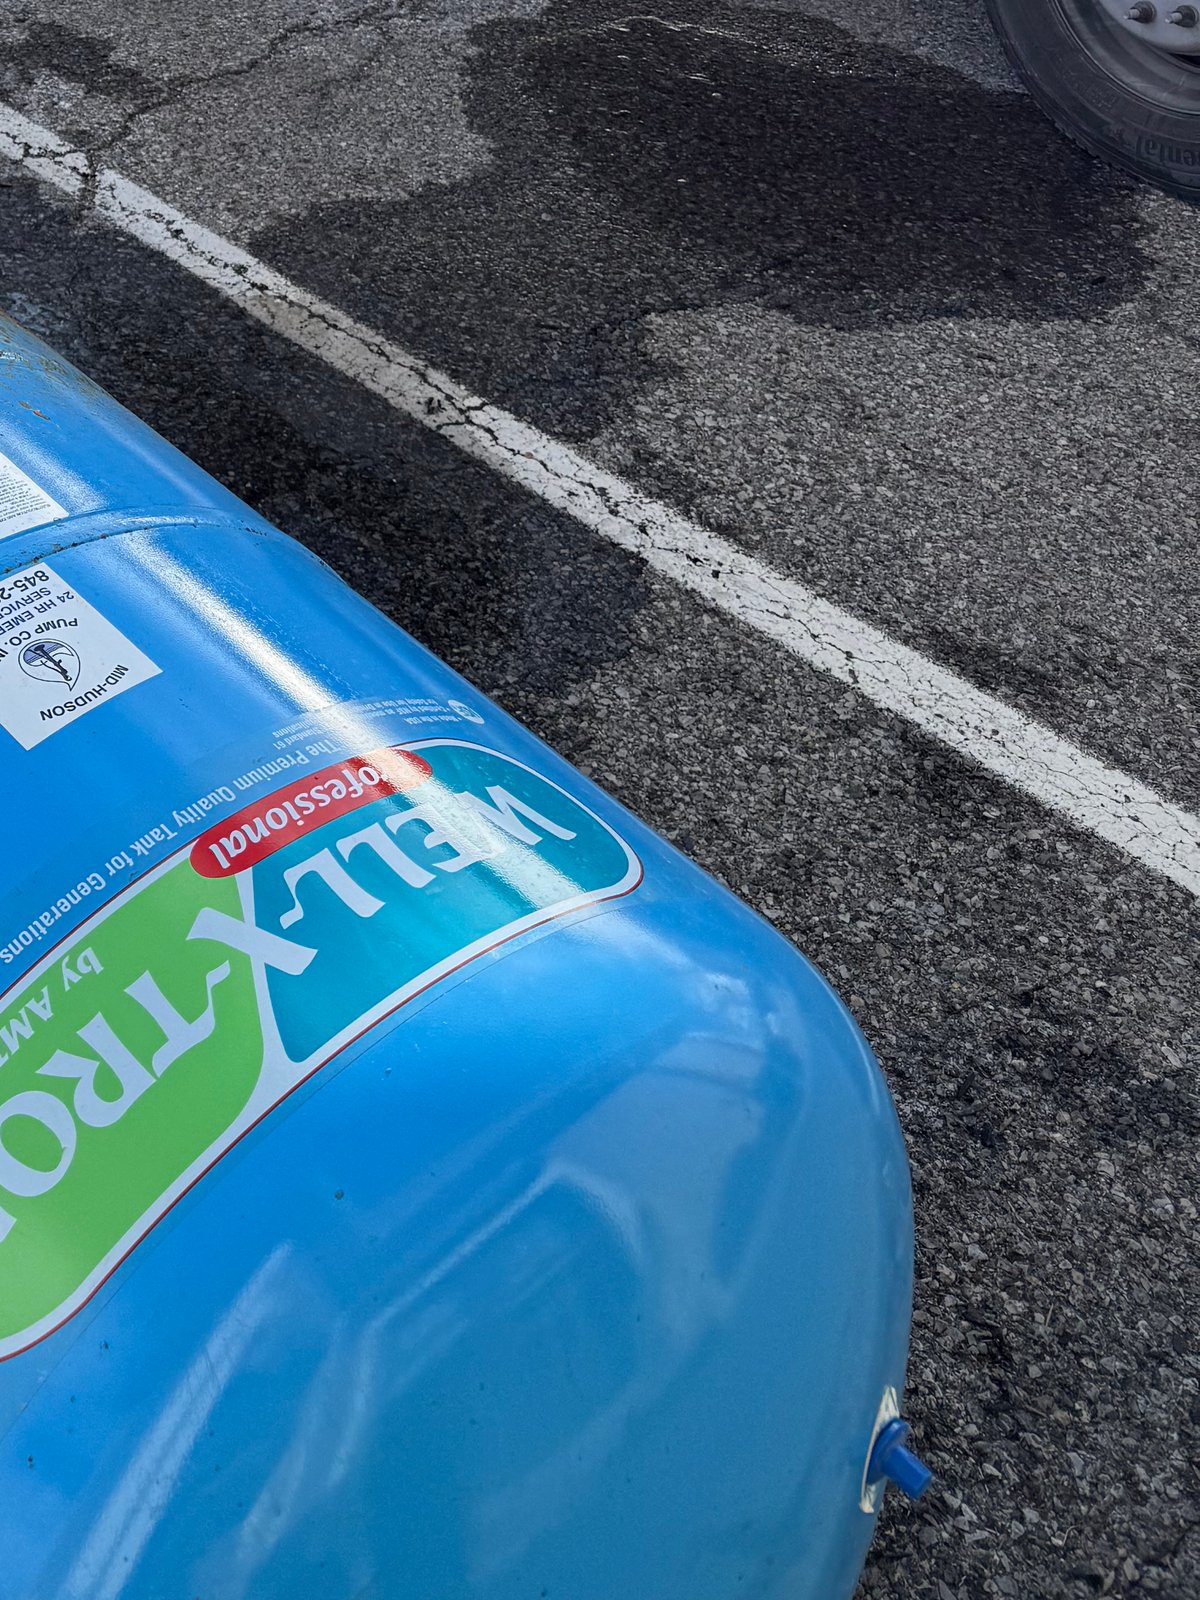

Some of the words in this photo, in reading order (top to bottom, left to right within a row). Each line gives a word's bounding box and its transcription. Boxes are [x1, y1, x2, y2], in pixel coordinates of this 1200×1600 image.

[34, 598, 57, 613] HR
[56, 590, 74, 602] 24
[4, 630, 32, 647] CO.
[34, 617, 79, 634] PUMP
[39, 664, 129, 721] MID-HUDSON
[274, 738, 287, 750] 61
[235, 750, 310, 791] Premium
[171, 787, 237, 829] Quality
[209, 757, 400, 869] ofessional
[129, 826, 178, 856] Tank
[105, 851, 135, 877] for
[63, 946, 104, 991] by
